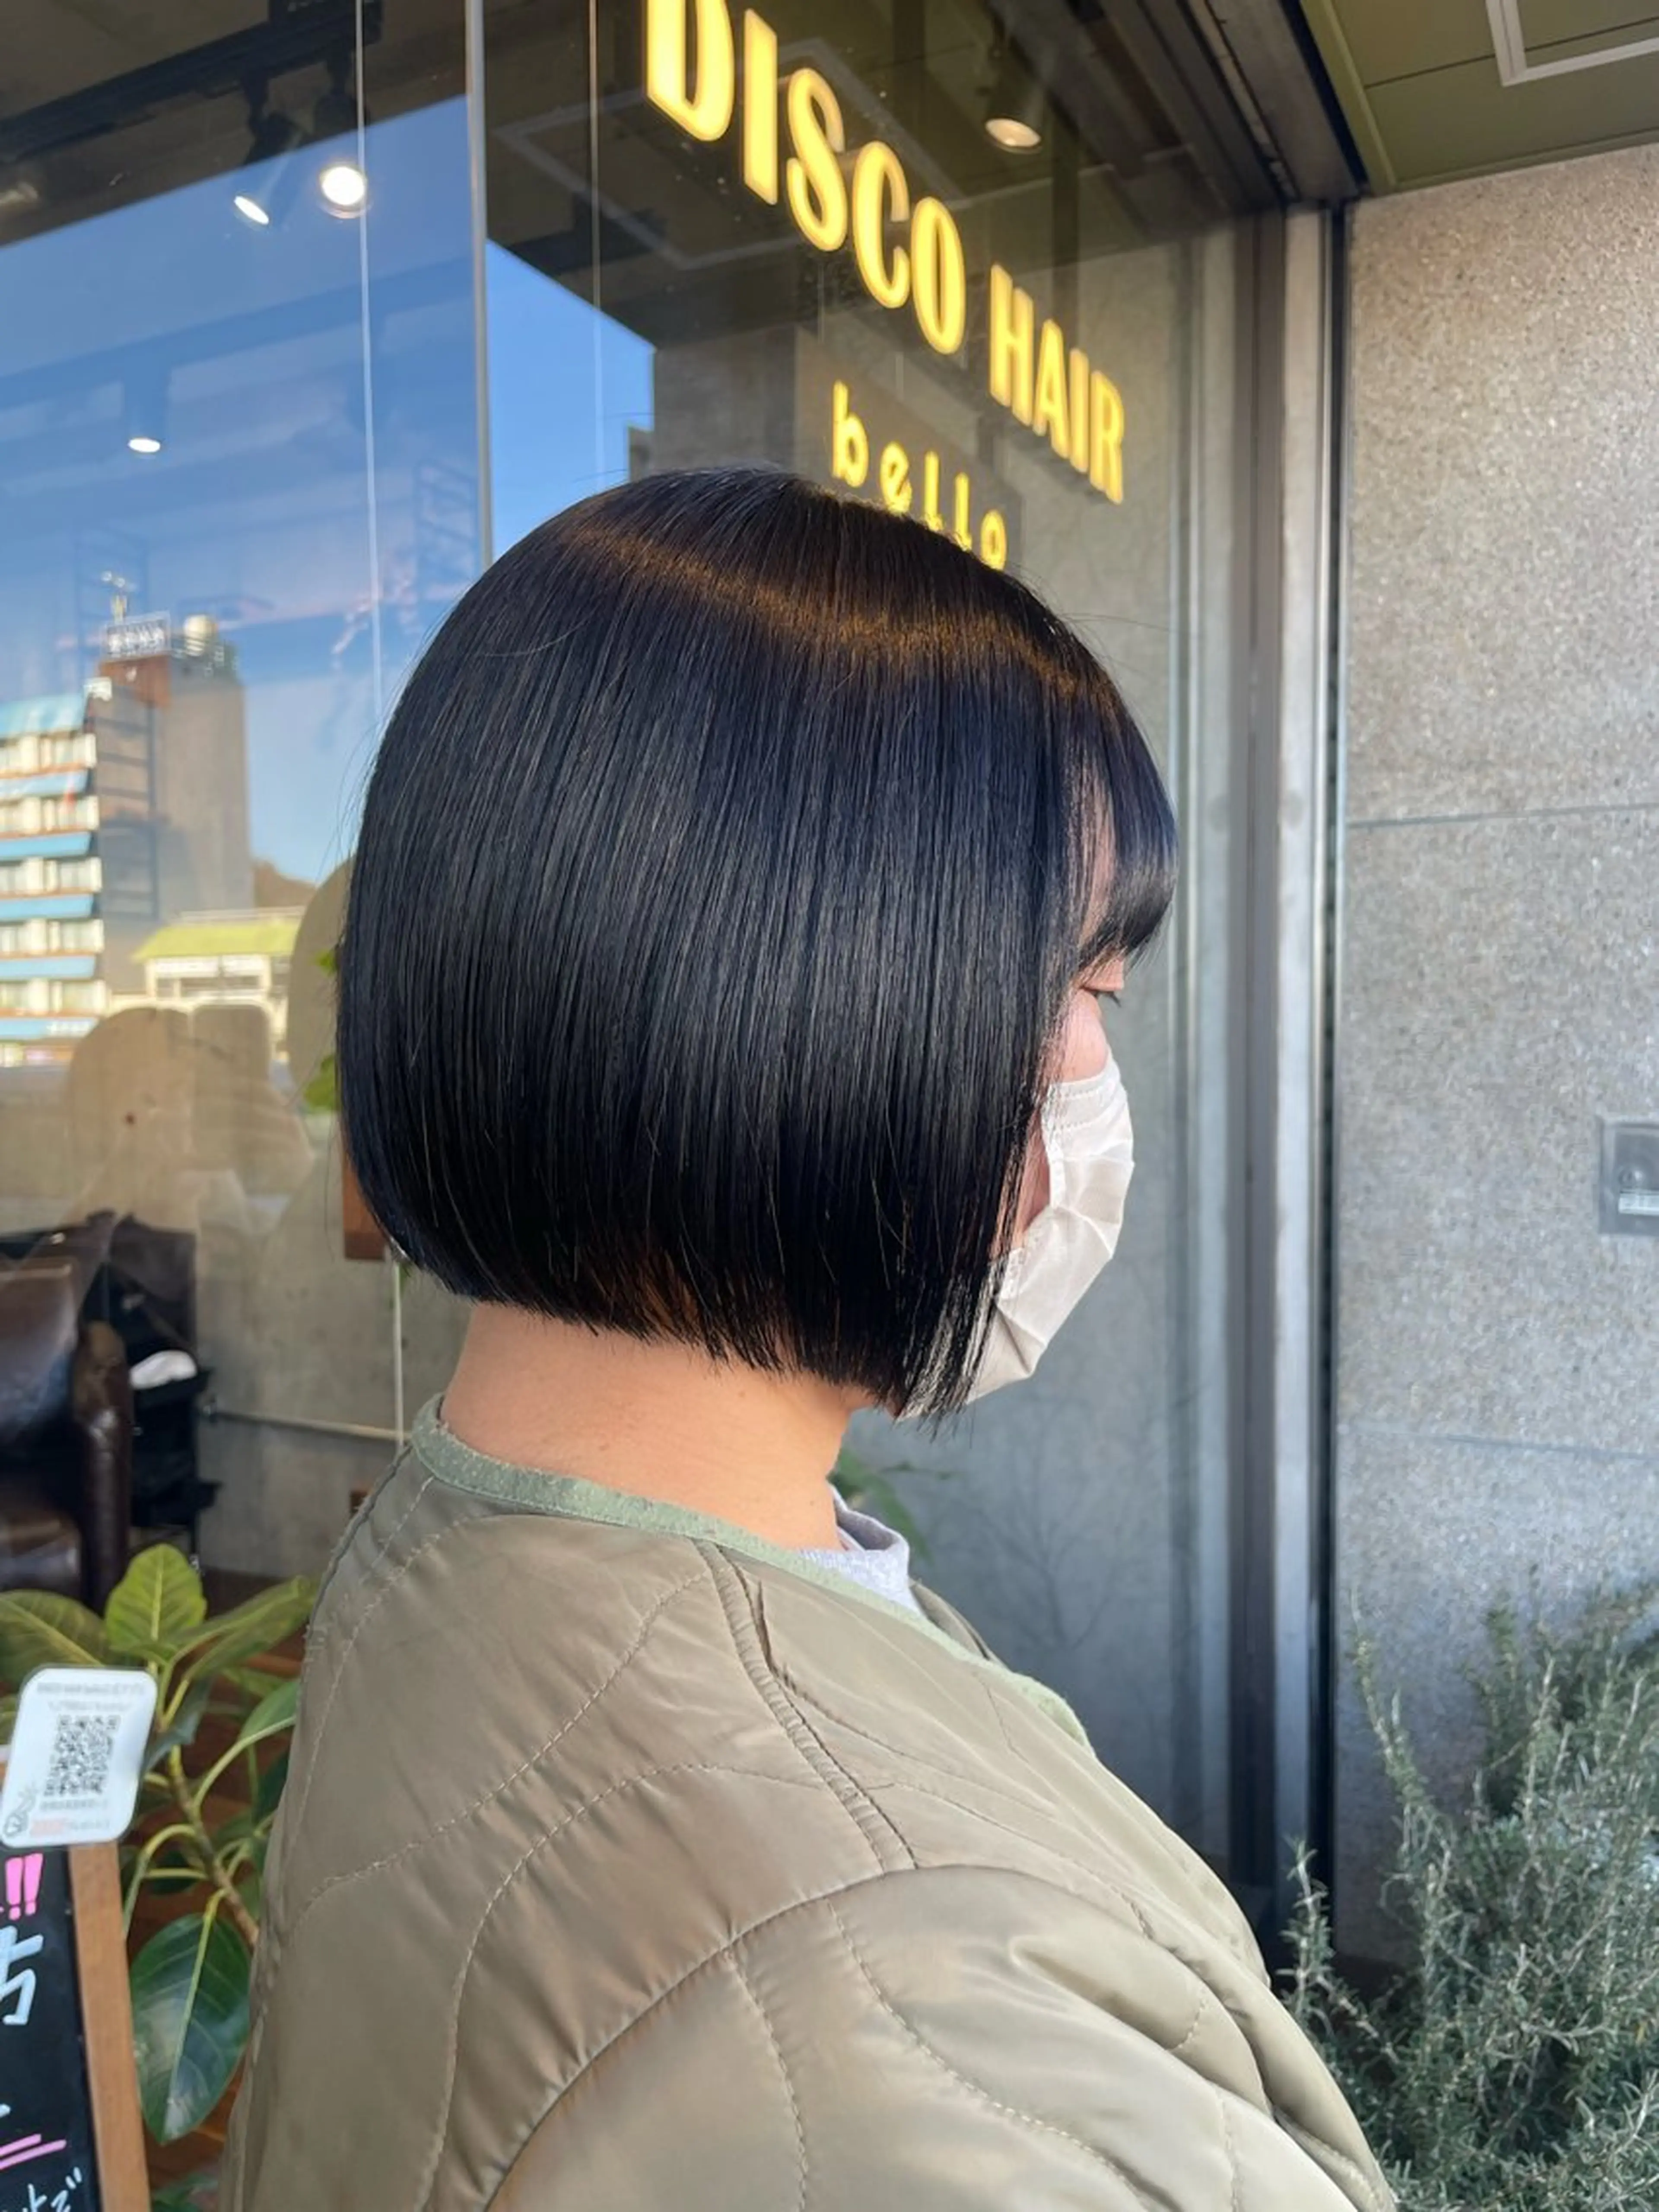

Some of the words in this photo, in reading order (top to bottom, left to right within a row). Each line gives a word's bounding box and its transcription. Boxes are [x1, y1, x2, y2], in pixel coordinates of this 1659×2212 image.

[646, 0, 966, 354] DISCO
[991, 264, 1124, 505] HAIR
[832, 375, 1007, 571] bello
